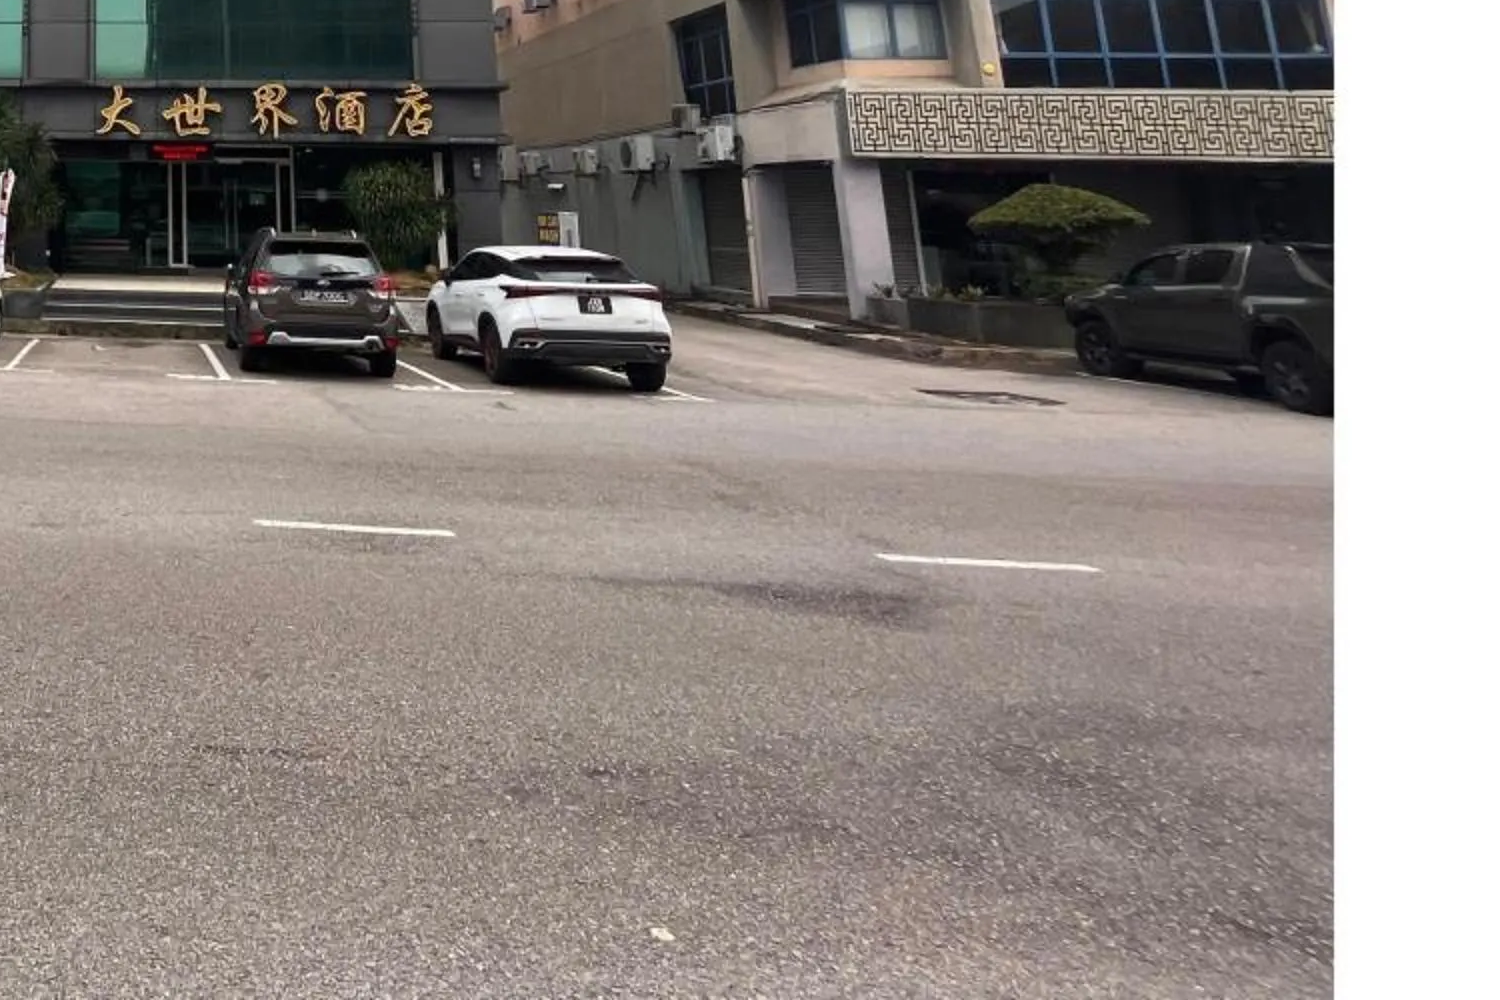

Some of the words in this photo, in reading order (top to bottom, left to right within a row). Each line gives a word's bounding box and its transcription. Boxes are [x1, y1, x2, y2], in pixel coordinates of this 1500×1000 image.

[96, 84, 434, 139] 大世界酒店
